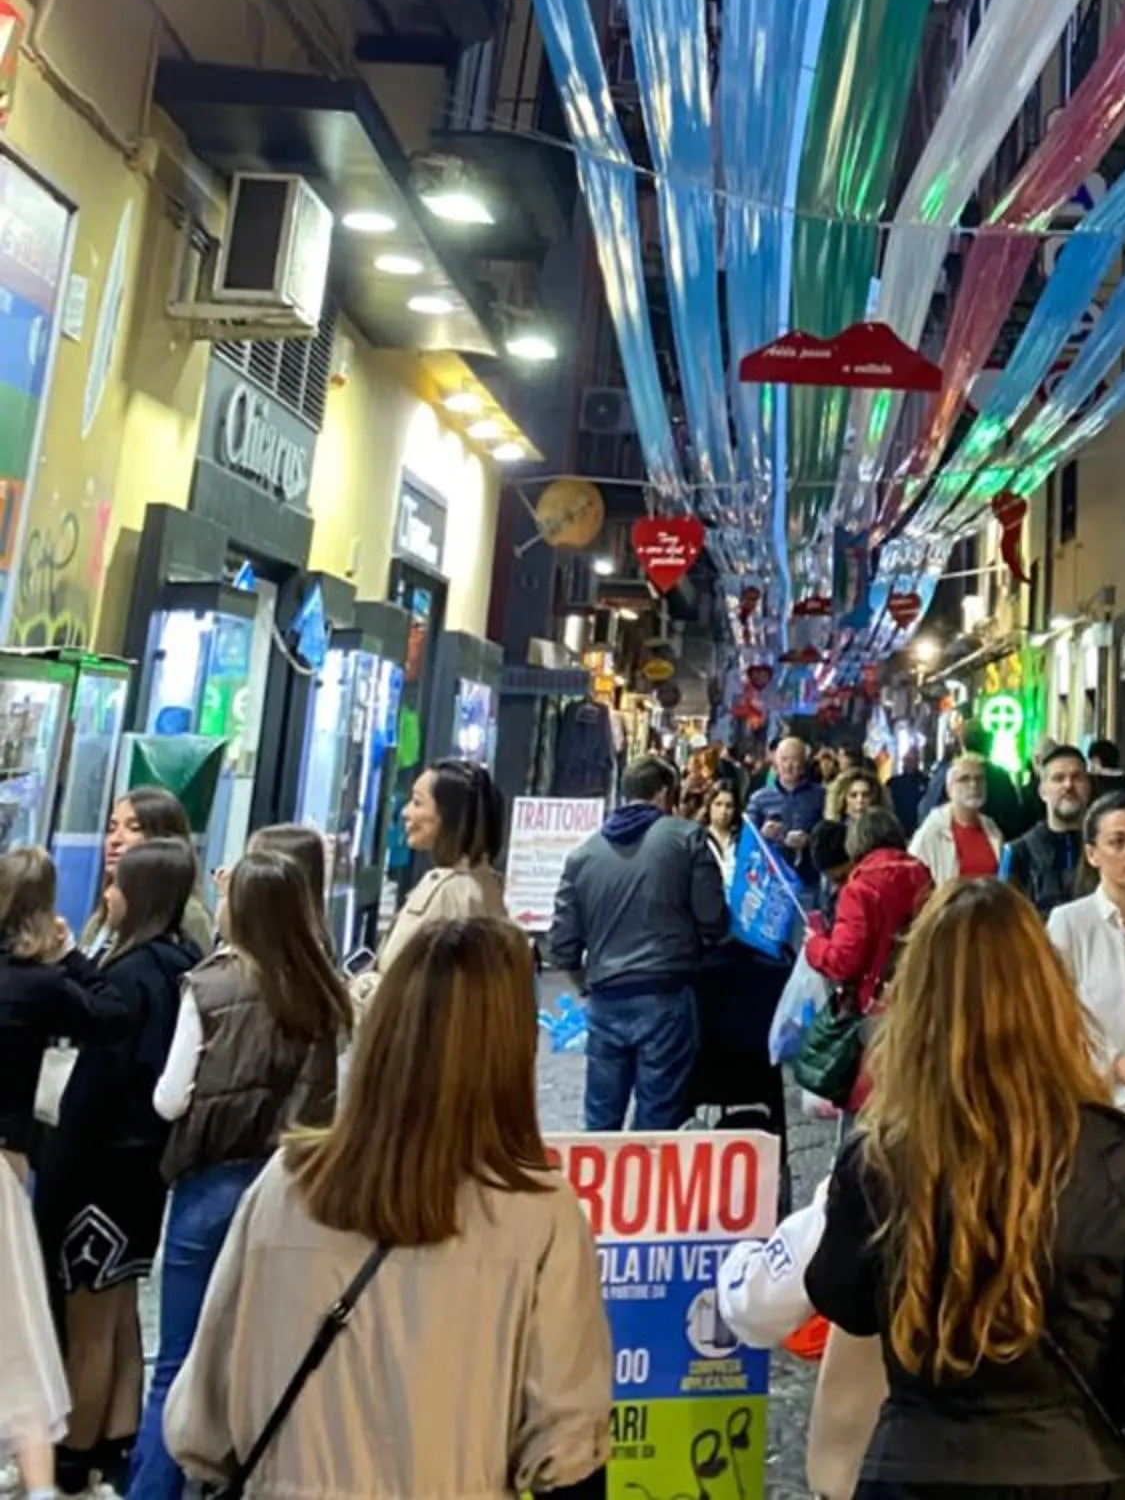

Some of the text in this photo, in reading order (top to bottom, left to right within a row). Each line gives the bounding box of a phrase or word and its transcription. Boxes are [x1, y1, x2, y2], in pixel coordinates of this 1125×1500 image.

[545, 1140, 758, 1237] ROMO
[647, 1245, 675, 1282] IN
[616, 1348, 650, 1384] 00
